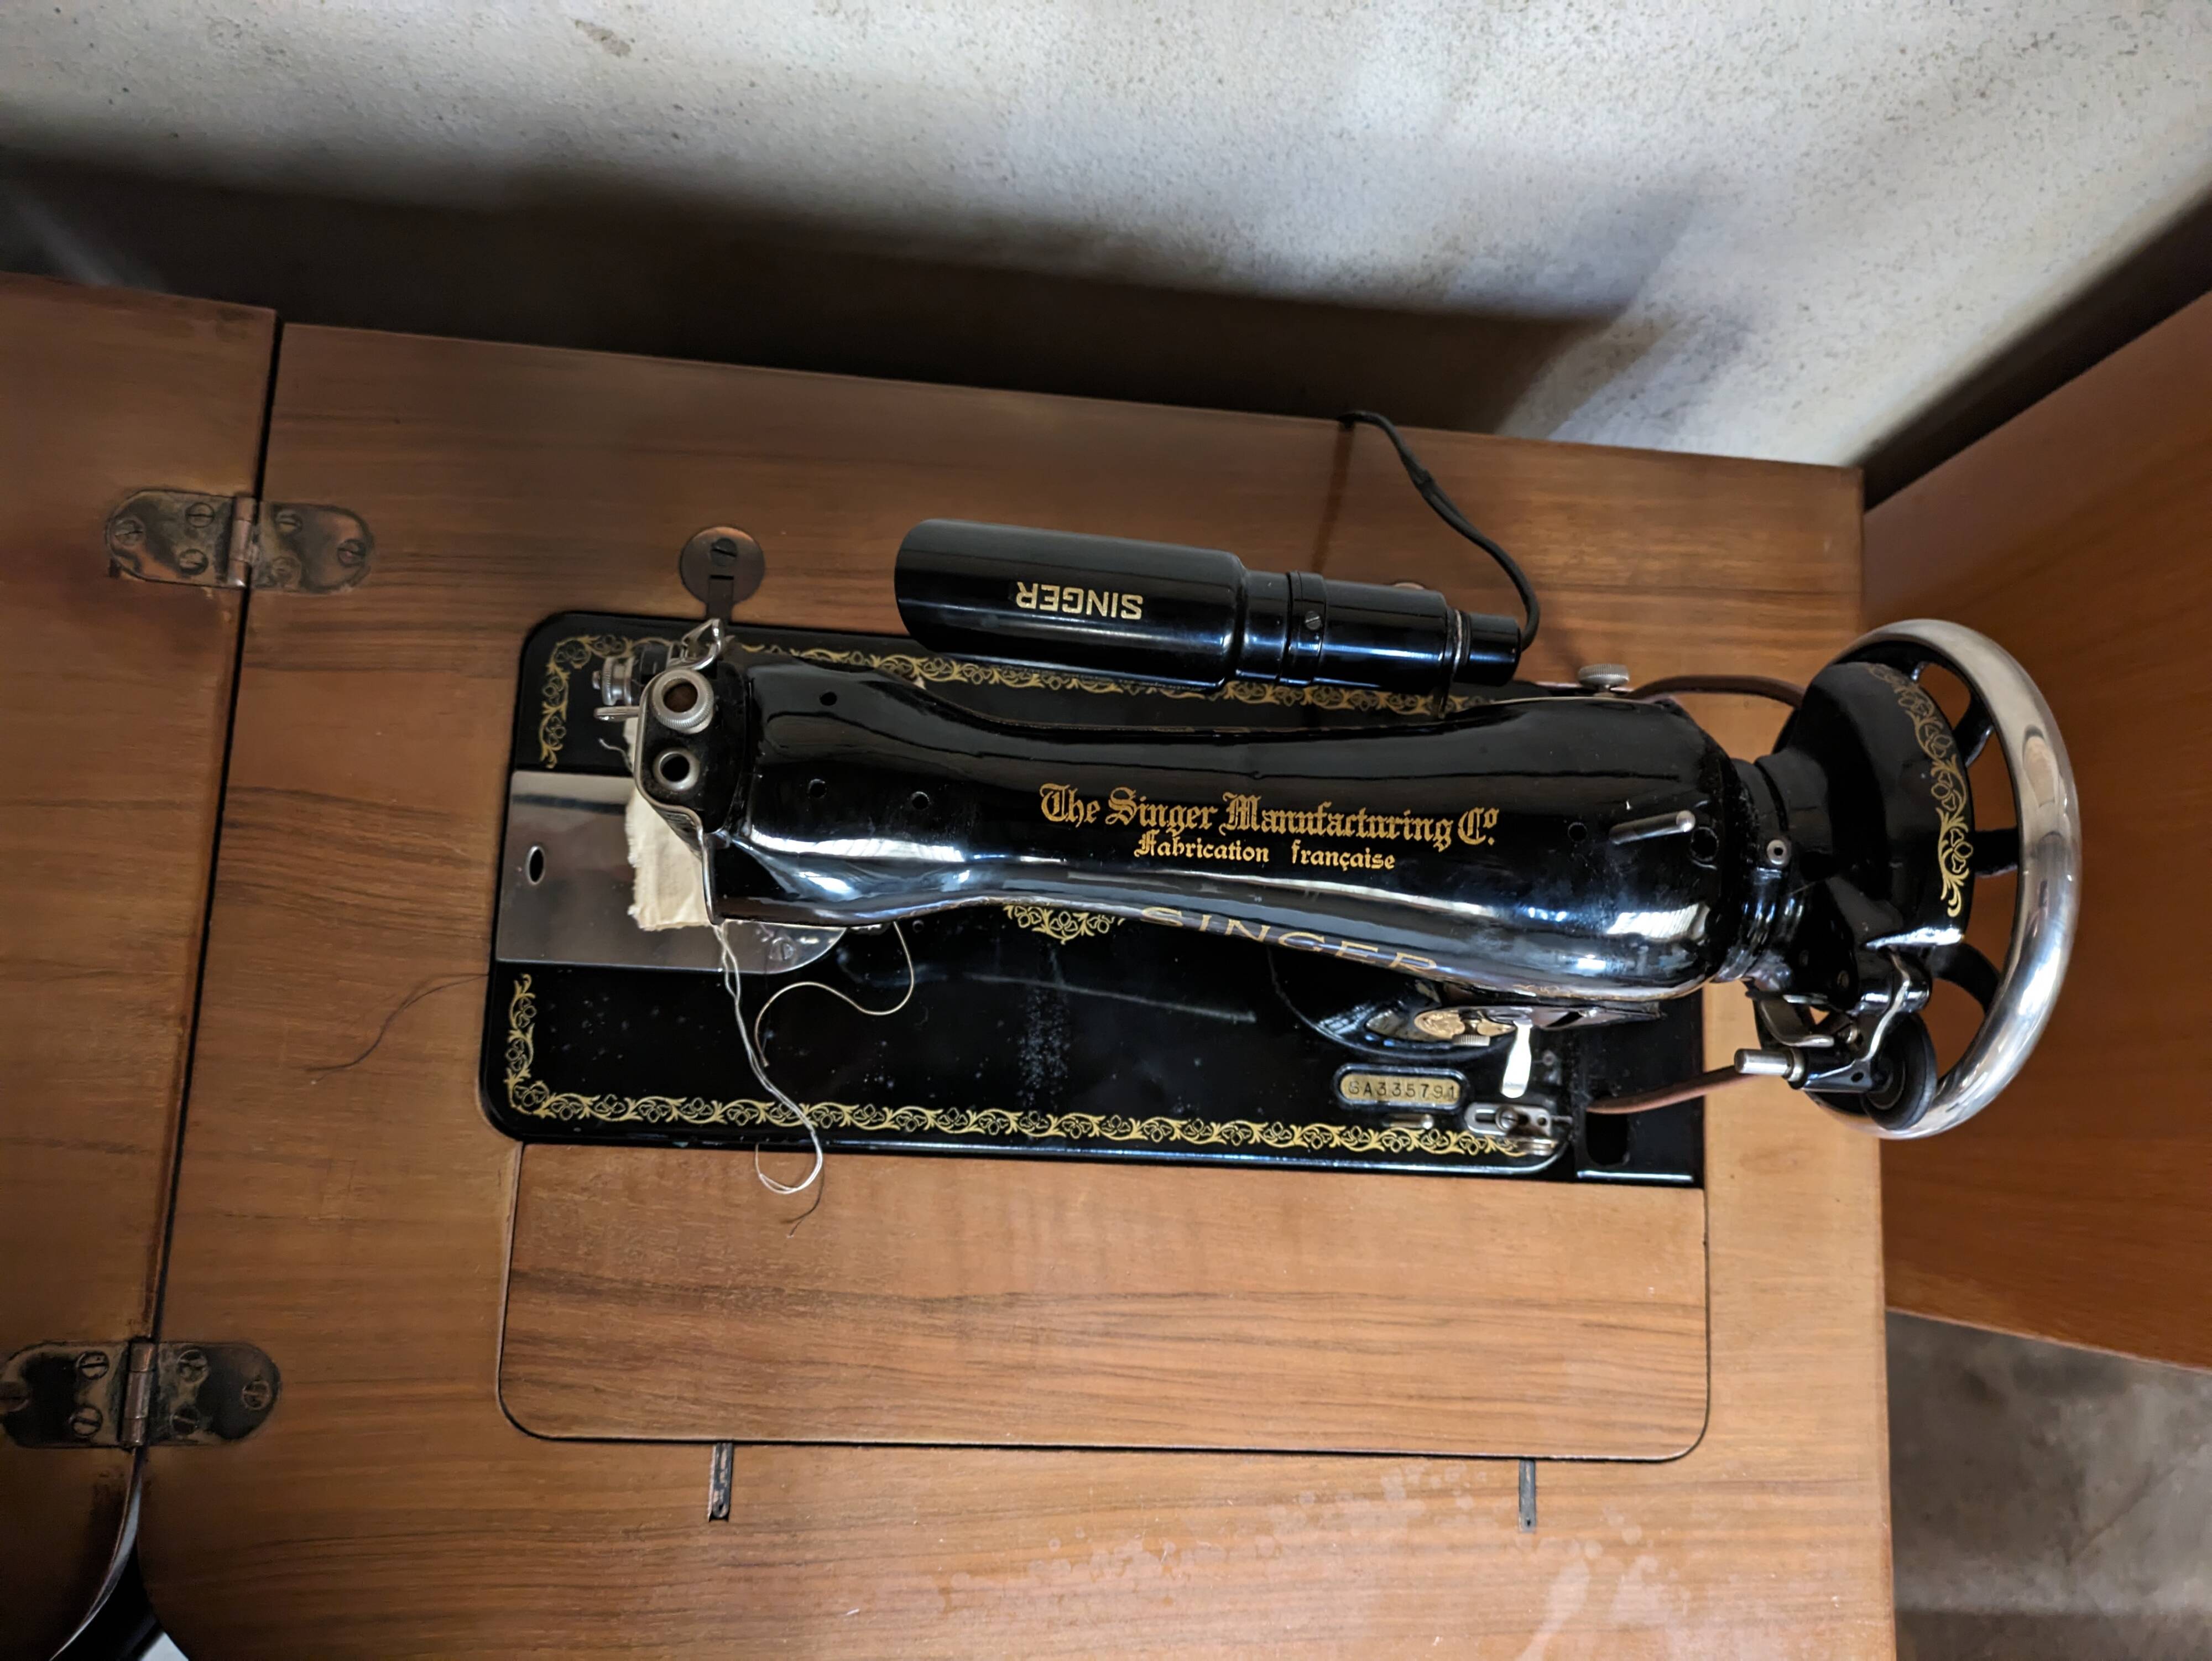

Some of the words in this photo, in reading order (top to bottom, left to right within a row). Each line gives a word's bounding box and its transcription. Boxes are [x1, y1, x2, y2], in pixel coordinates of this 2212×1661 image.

[1016, 582, 1143, 620] SINGER
[1040, 783, 1100, 827] The
[1105, 787, 1218, 837] Singer
[1218, 792, 1453, 852] Manufacturing
[1134, 830, 1269, 862] Fabrication
[1291, 840, 1395, 871] française
[1140, 907, 1437, 971] SINGER
